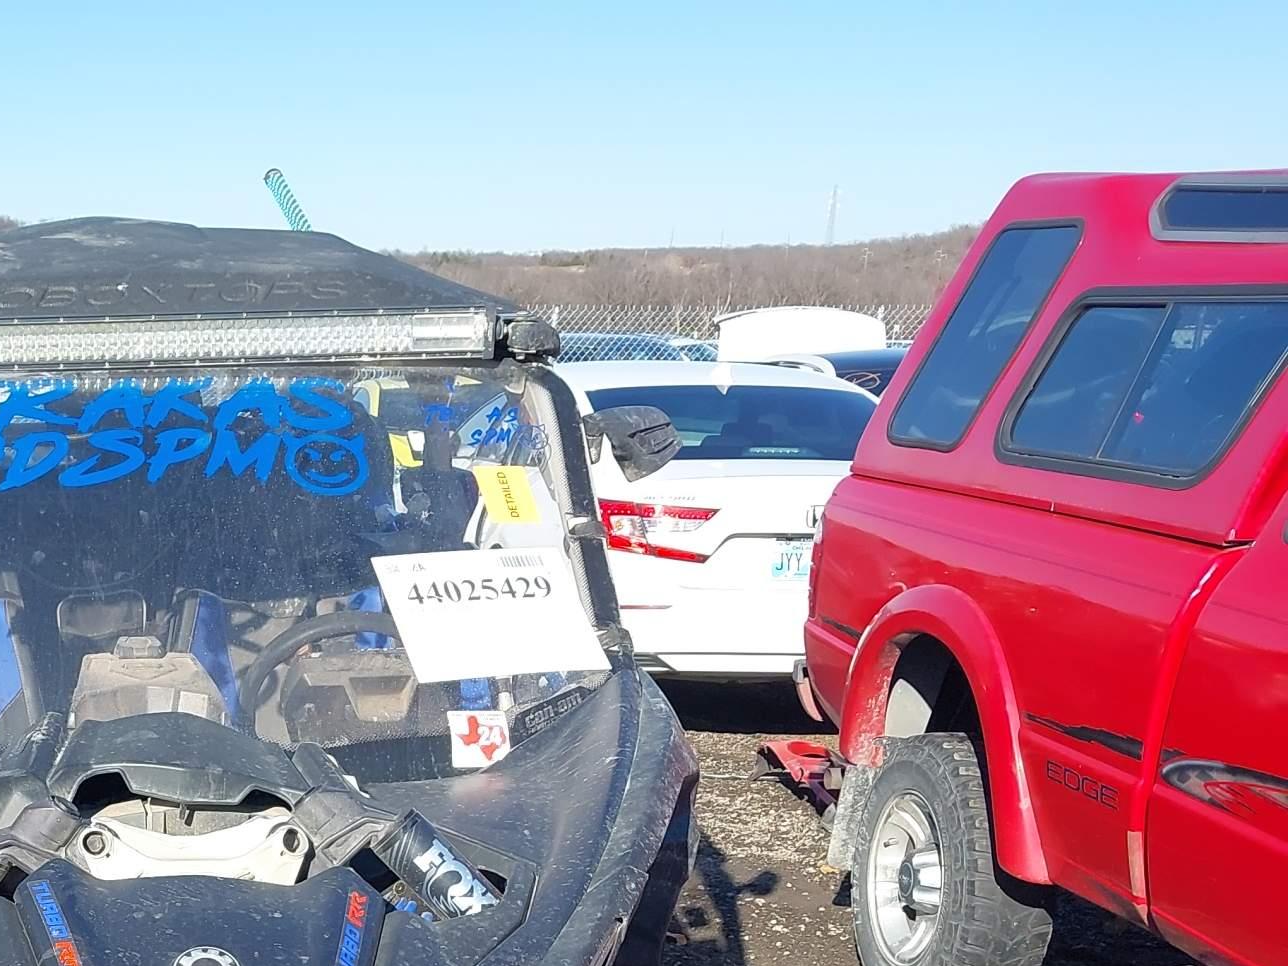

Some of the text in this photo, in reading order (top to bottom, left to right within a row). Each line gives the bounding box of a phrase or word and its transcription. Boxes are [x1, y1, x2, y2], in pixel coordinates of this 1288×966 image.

[496, 470, 521, 519] DETAILED
[775, 552, 803, 572] JYY
[407, 575, 552, 605] 44025429
[480, 725, 502, 746] 24
[1046, 759, 1119, 811] EDGE
[412, 838, 500, 917] FOX
